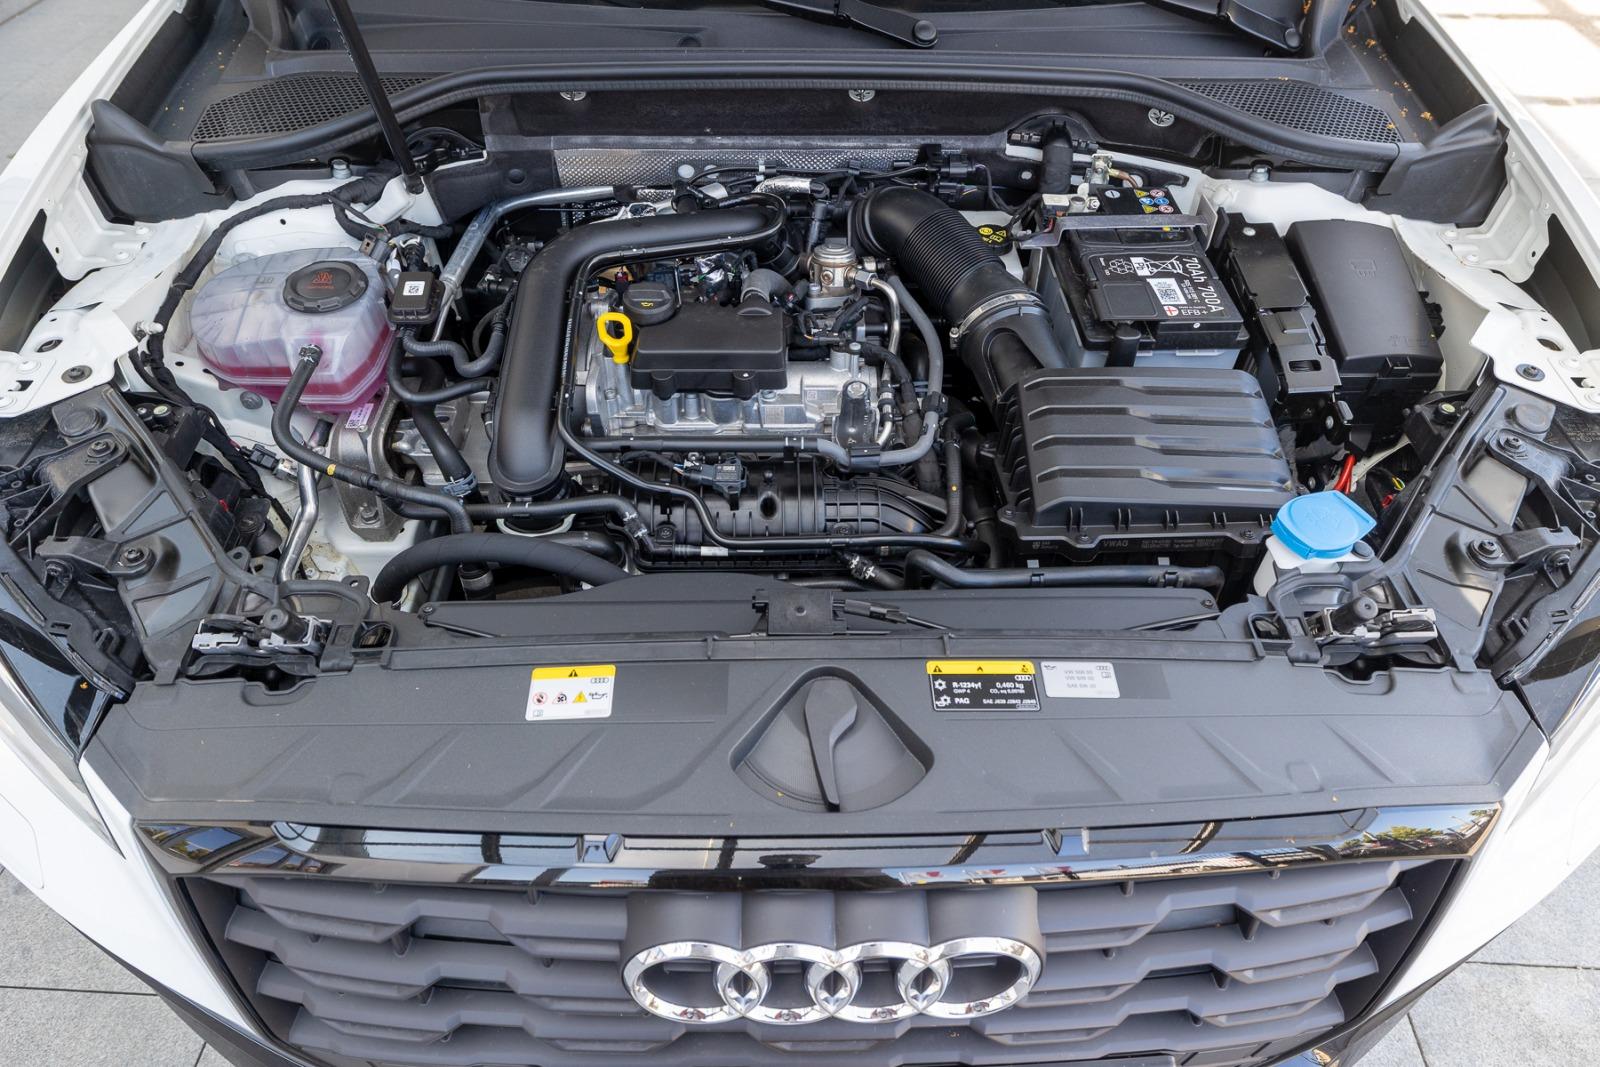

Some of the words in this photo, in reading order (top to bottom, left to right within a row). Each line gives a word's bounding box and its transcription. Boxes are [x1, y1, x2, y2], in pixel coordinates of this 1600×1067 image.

[1182, 257, 1208, 283] 70Ah
[1198, 286, 1225, 313] 700A
[952, 682, 982, 690] R-1234yf
[1015, 682, 1025, 690] kg
